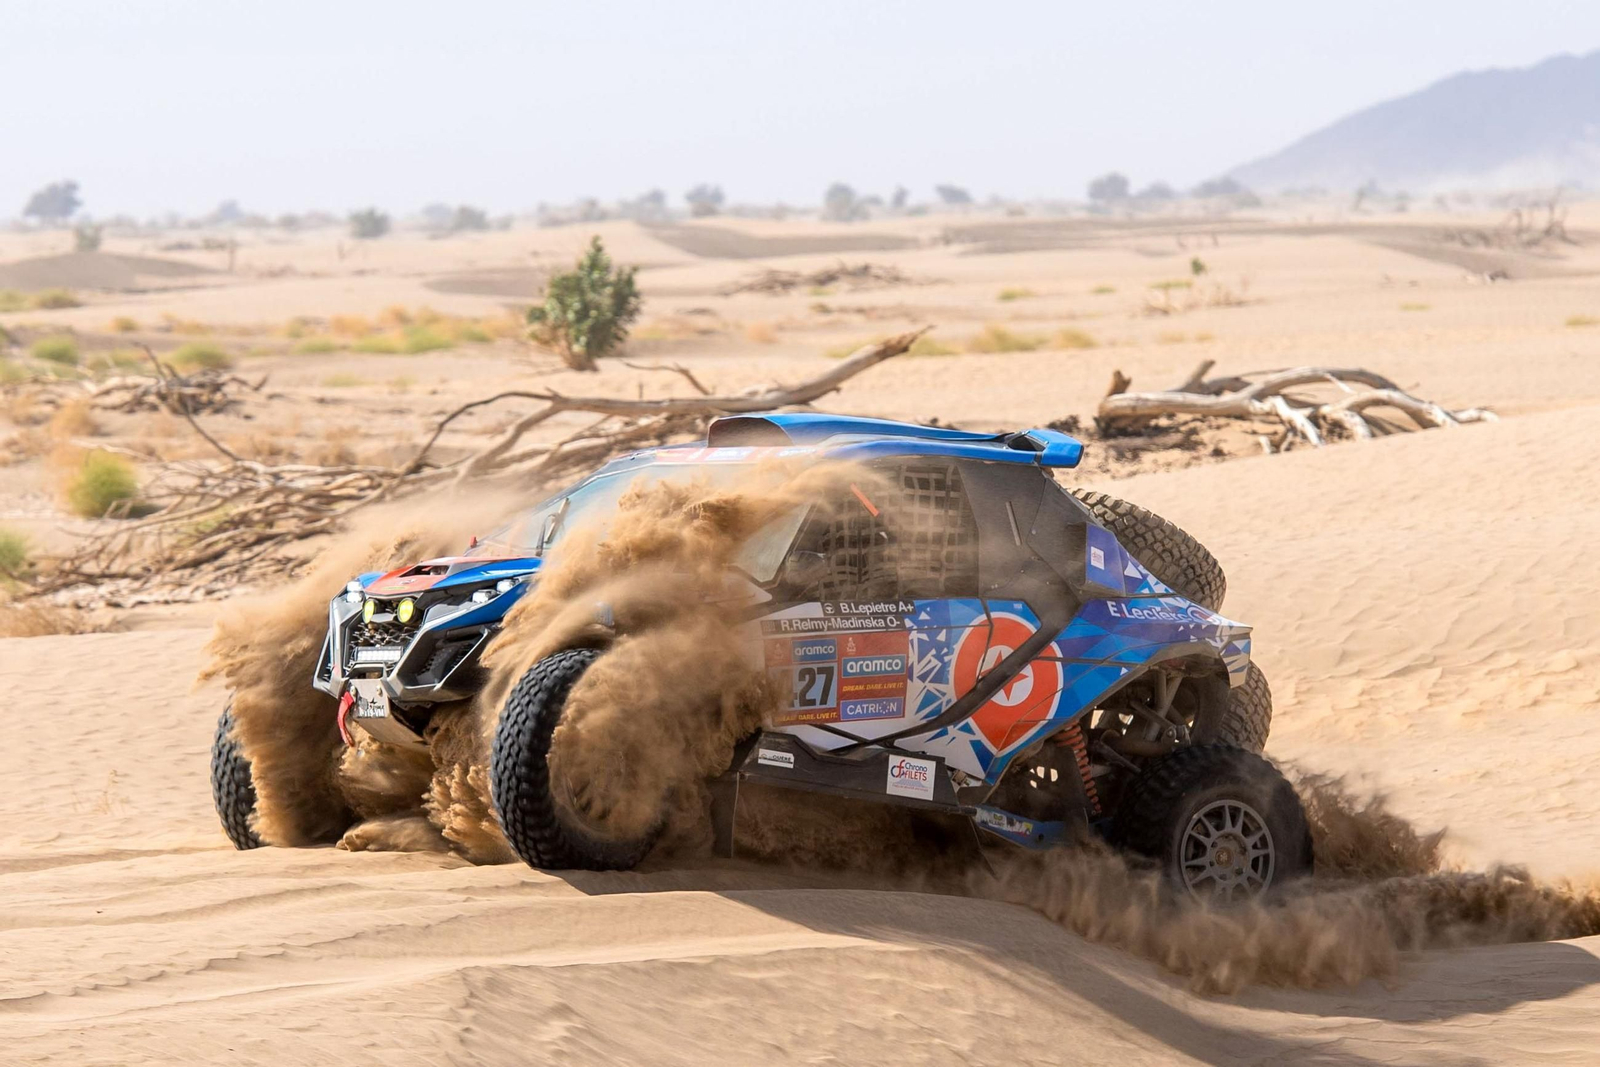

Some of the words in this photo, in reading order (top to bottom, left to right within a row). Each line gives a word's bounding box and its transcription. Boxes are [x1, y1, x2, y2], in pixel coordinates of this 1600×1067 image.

[841, 602, 897, 615] B.Lepietre
[898, 601, 914, 612] A+
[1107, 601, 1191, 622] E.Leclerc
[794, 645, 835, 656] aramco
[847, 659, 902, 673] aramco
[905, 762, 927, 773] Chrono
